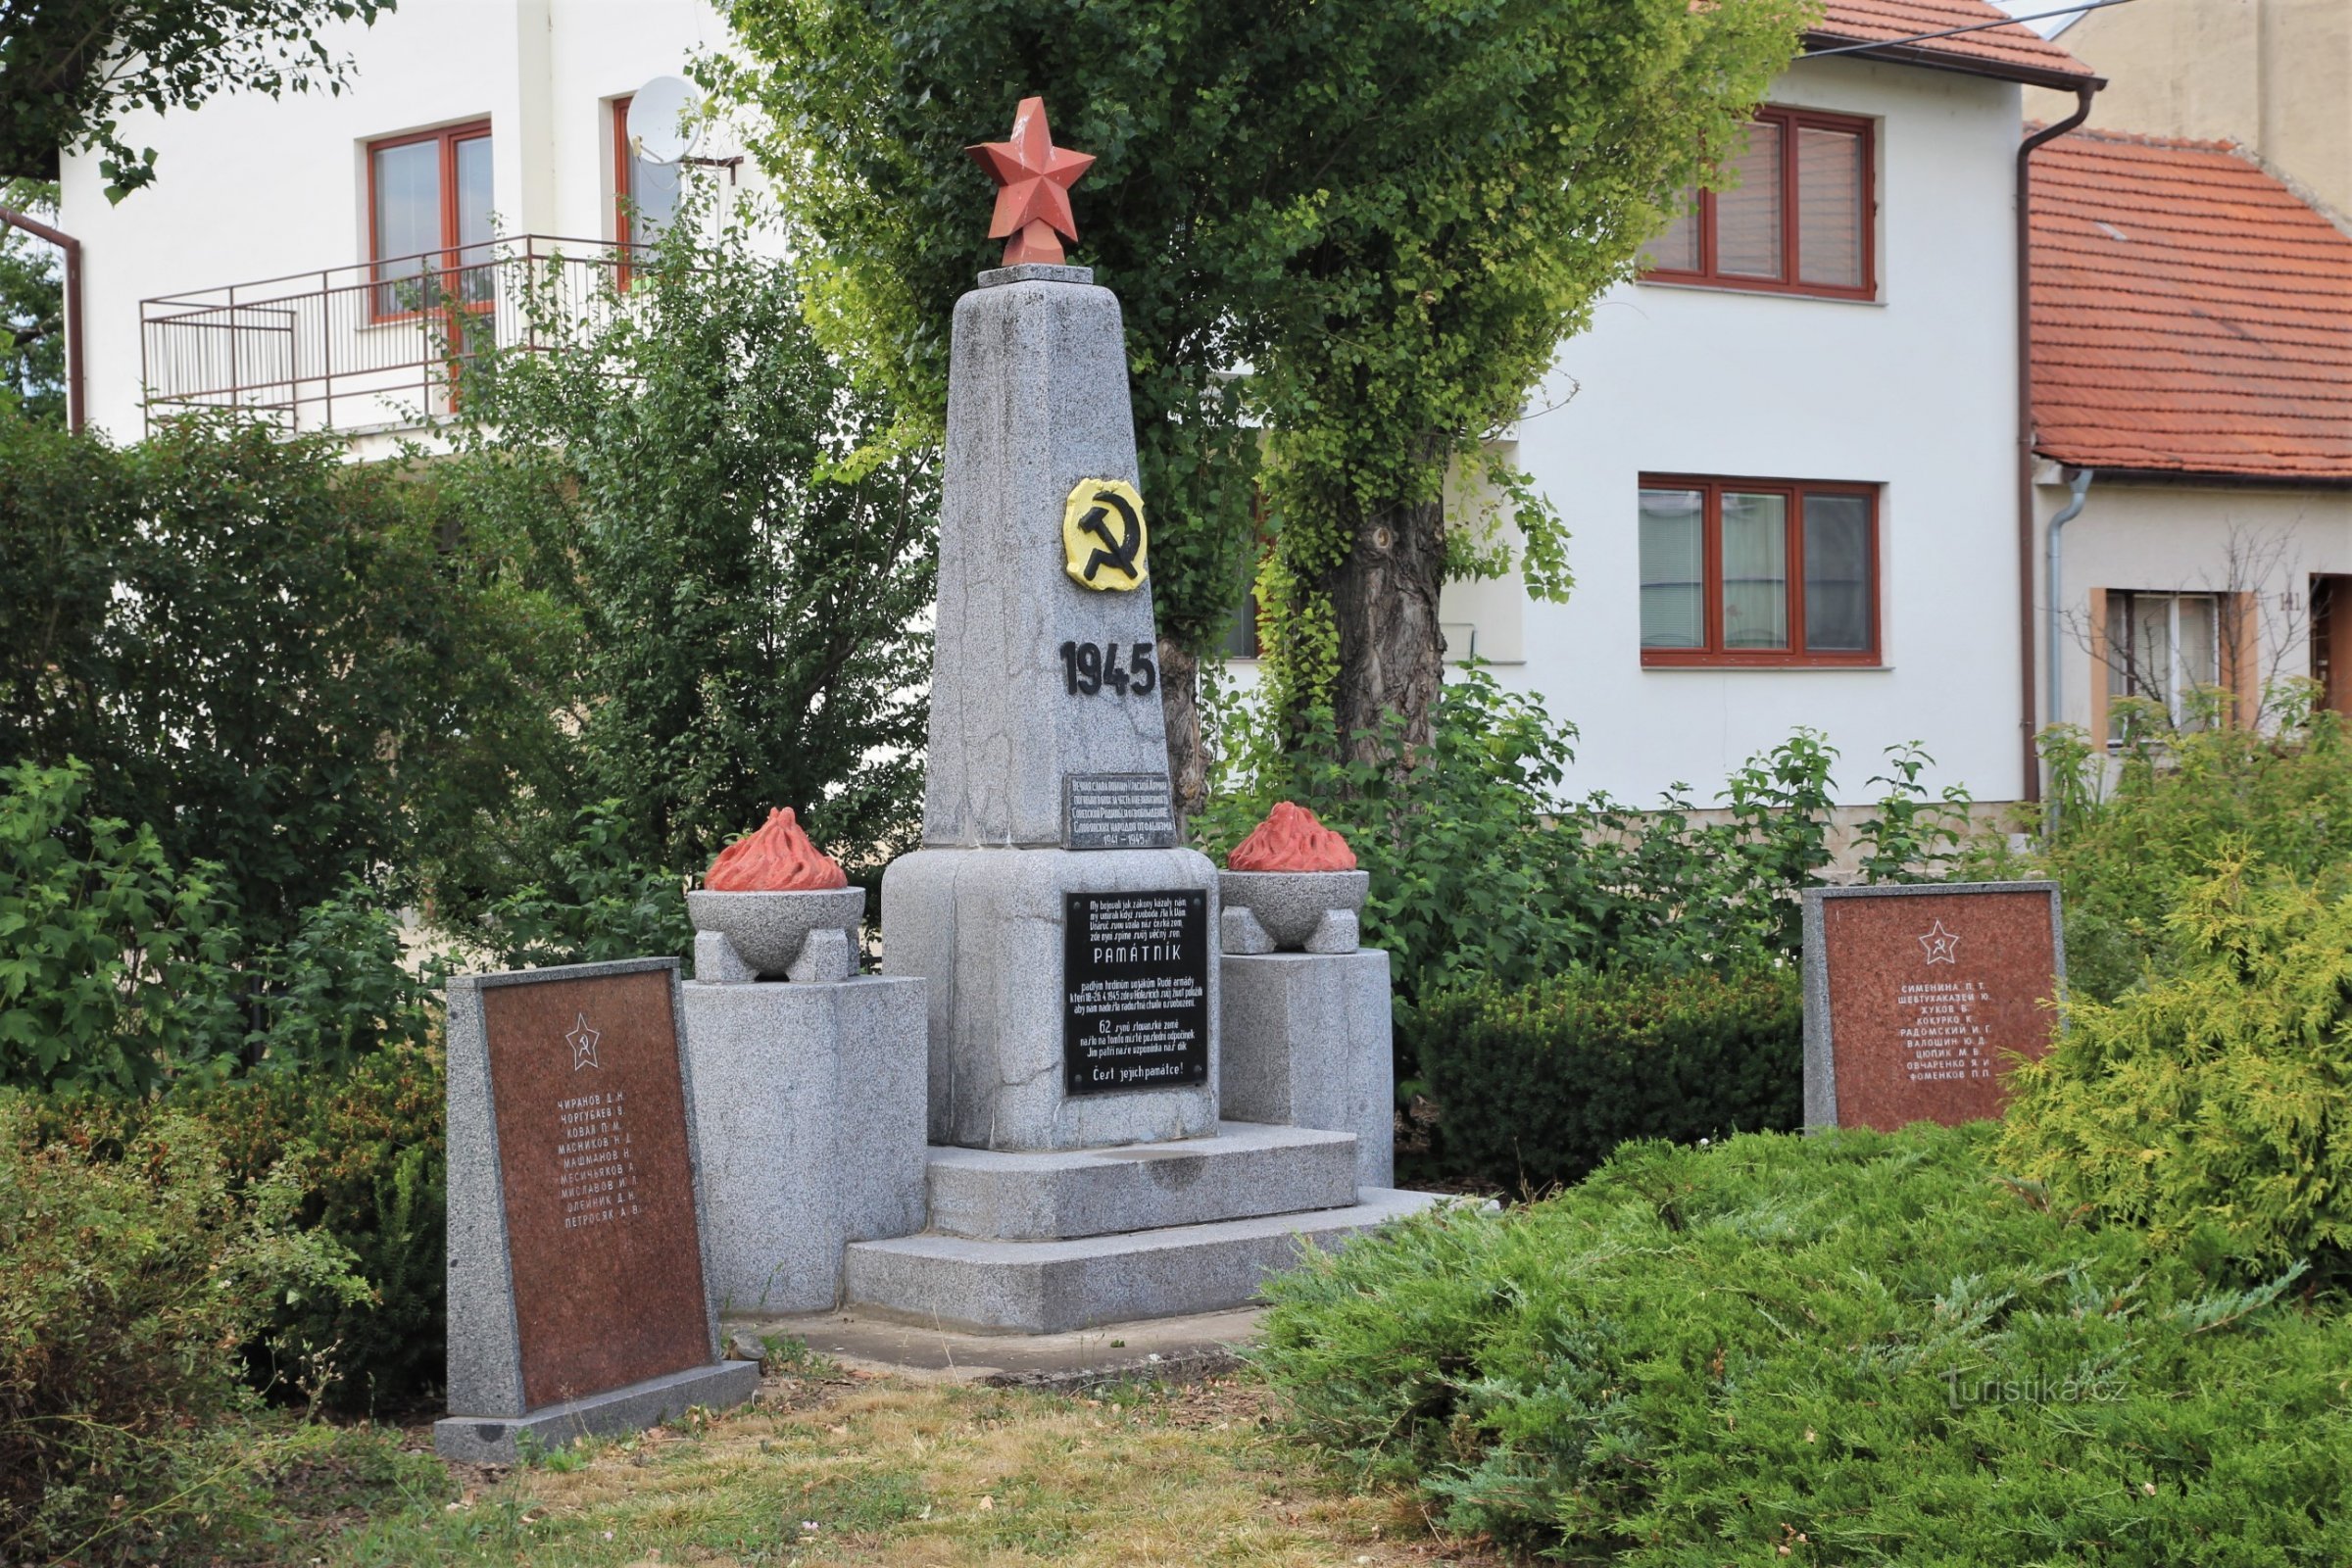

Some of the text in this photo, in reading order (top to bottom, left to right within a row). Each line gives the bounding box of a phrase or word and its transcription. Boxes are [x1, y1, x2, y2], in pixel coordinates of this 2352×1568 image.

[1060, 641, 1155, 696] 1945
[1094, 941, 1181, 963] PAMÁTNÍK
[1902, 983, 1958, 993] СИМЕНИНА
[1099, 1019, 1111, 1033] 62
[1093, 1062, 1183, 1082] Čest jejich památce!
[1907, 1060, 1964, 1070] ОВЧАРЕНКО
[557, 1095, 600, 1110] ЧИРАНОВ
[561, 1108, 612, 1124] ЧОРГУБАЕВ
[558, 1137, 609, 1155] МАСНИКОВ
[564, 1150, 618, 1169] МАШМАНОВ
[565, 1209, 613, 1228] ПЕТРОСЯК
